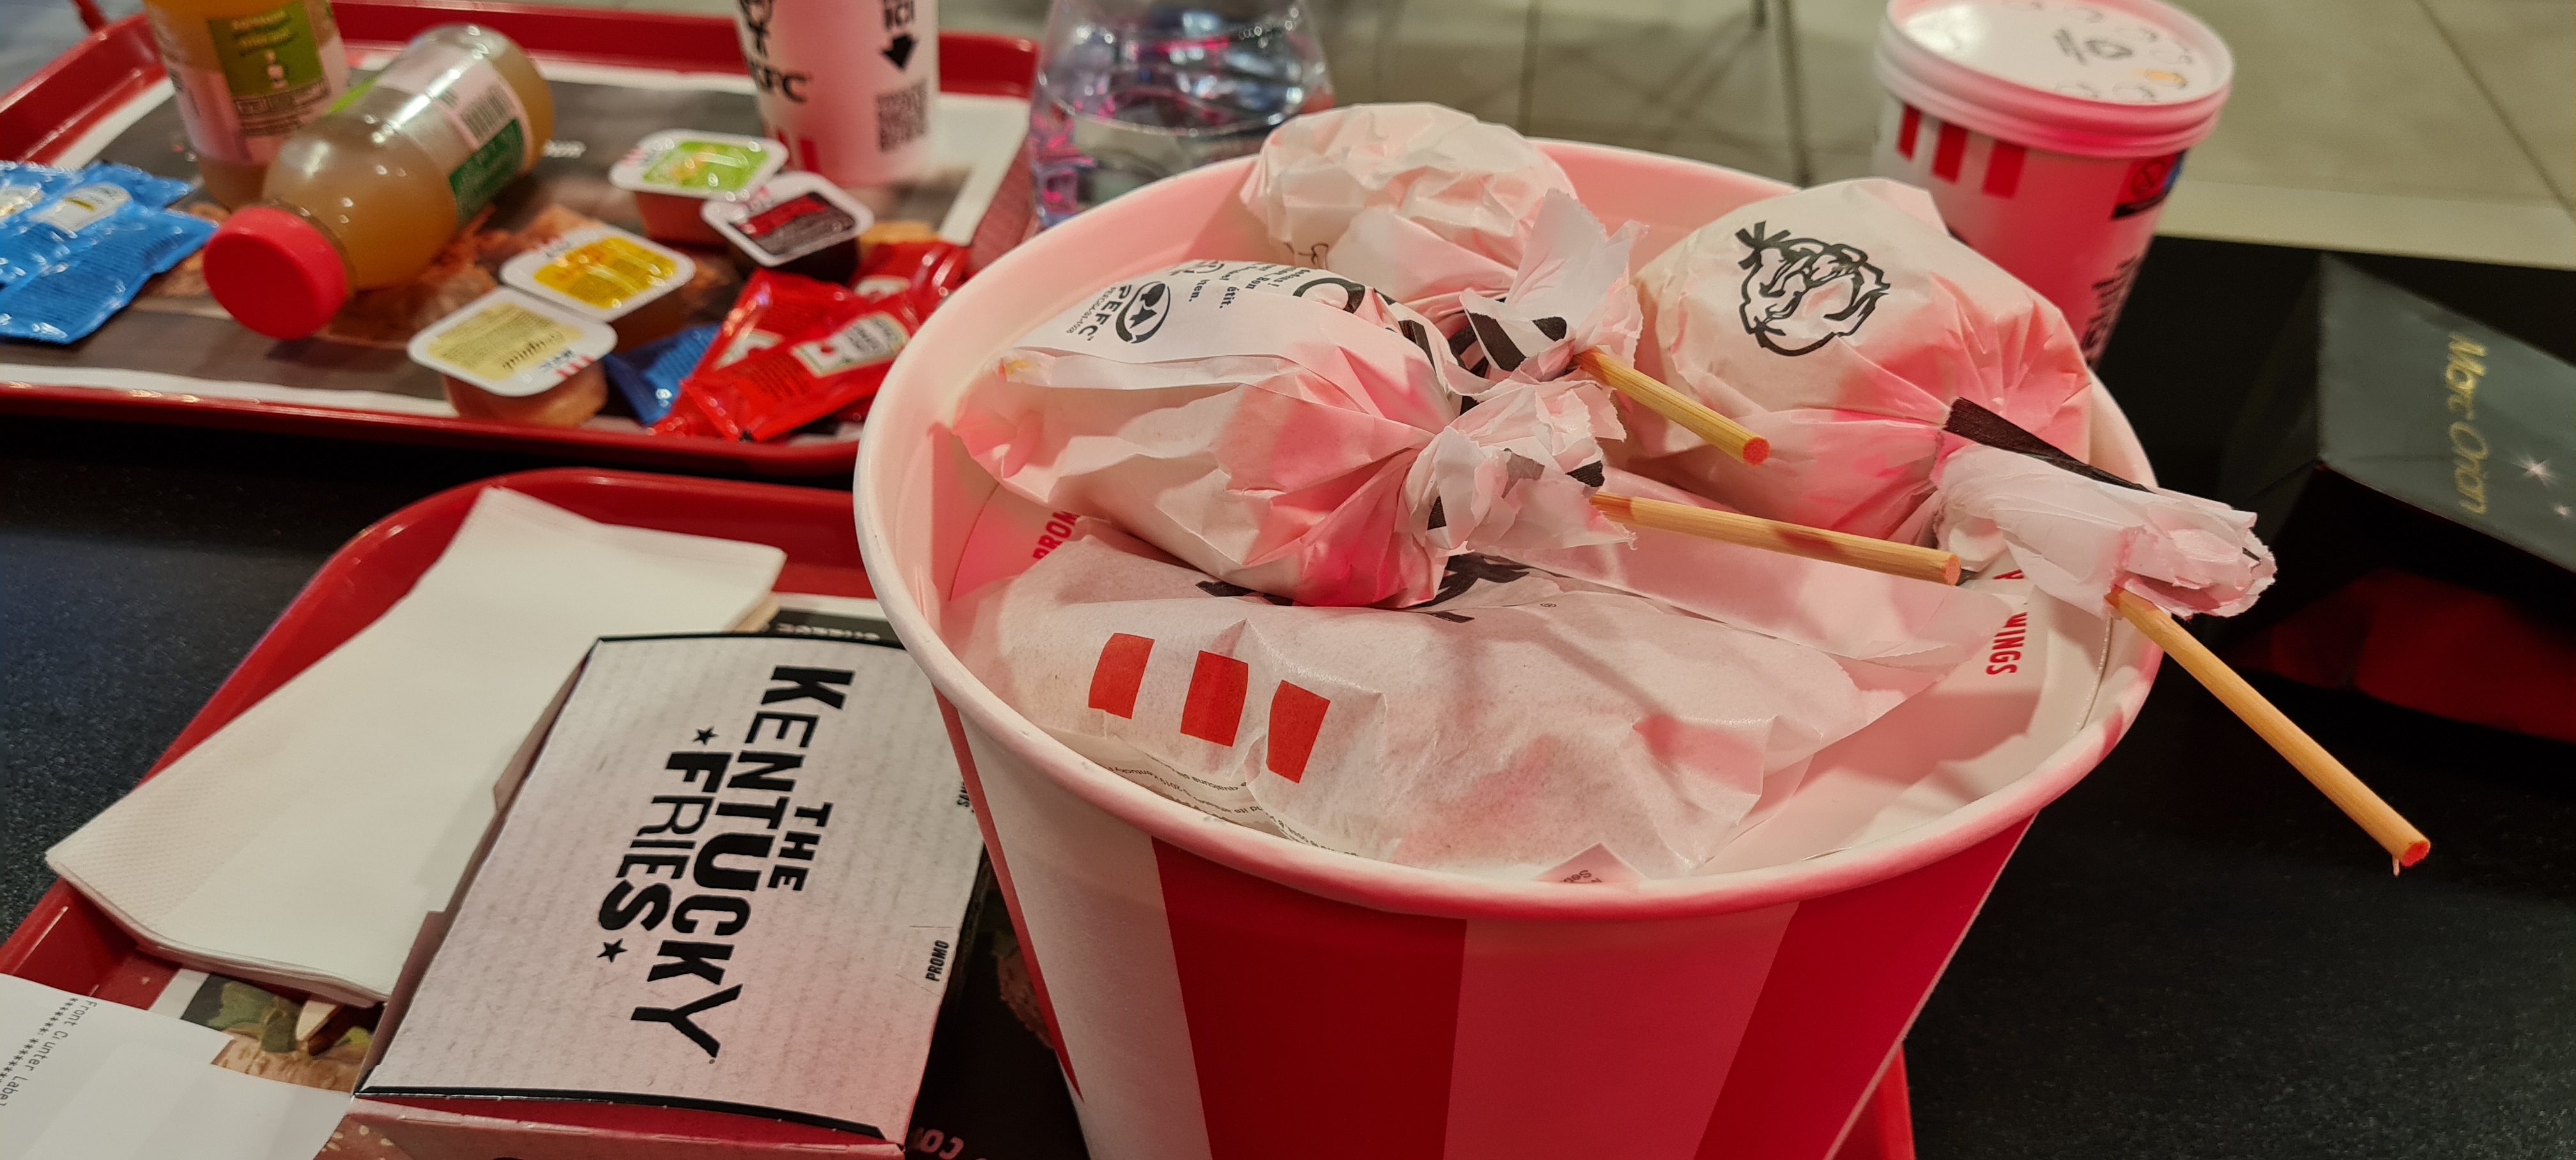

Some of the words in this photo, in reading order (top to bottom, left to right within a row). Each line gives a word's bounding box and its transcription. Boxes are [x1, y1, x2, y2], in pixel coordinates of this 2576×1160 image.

[1219, 286, 1240, 309] étit.
[1032, 510, 1080, 560] PROM
[1986, 611, 2028, 675] WINGS
[599, 750, 733, 931] FRIES
[630, 665, 855, 1058] KENTUCKY
[767, 802, 834, 891] THE
[926, 940, 949, 982] PROMO
[64, 1000, 98, 1026] Front
